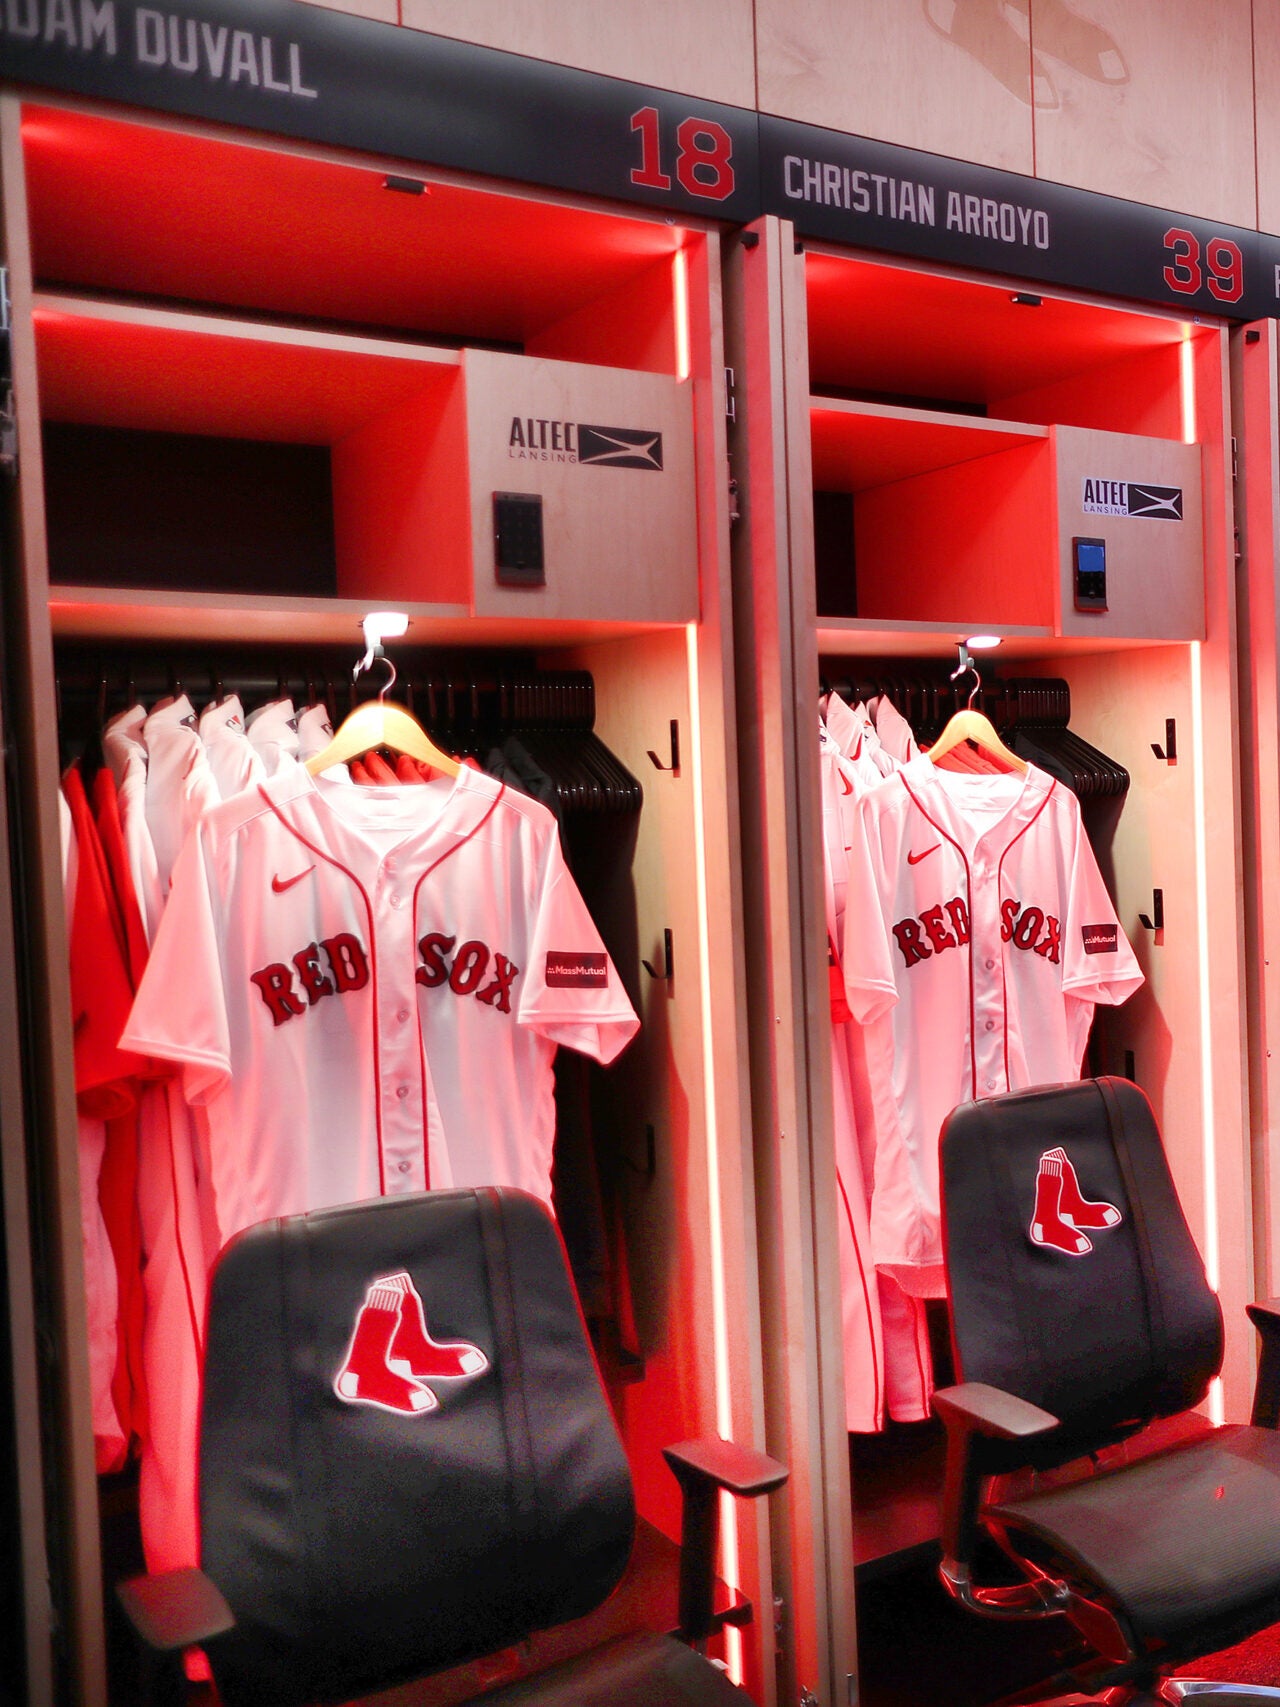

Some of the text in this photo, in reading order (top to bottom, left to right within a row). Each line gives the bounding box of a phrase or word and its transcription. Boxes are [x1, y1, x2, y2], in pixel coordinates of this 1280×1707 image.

[0, 0, 318, 98] DAM DUVALL
[630, 106, 735, 200] 18
[783, 155, 1049, 250] CHRISTIAN ARROYO
[1163, 227, 1244, 303] 39
[509, 417, 577, 452] ALTEC
[509, 450, 577, 463] LANSING
[1083, 504, 1128, 516] LANSING
[1084, 479, 1127, 506] ALTEC
[892, 897, 1062, 968] RED SOX
[250, 932, 519, 1026] RED SOX
[555, 965, 606, 975] MassMutual
